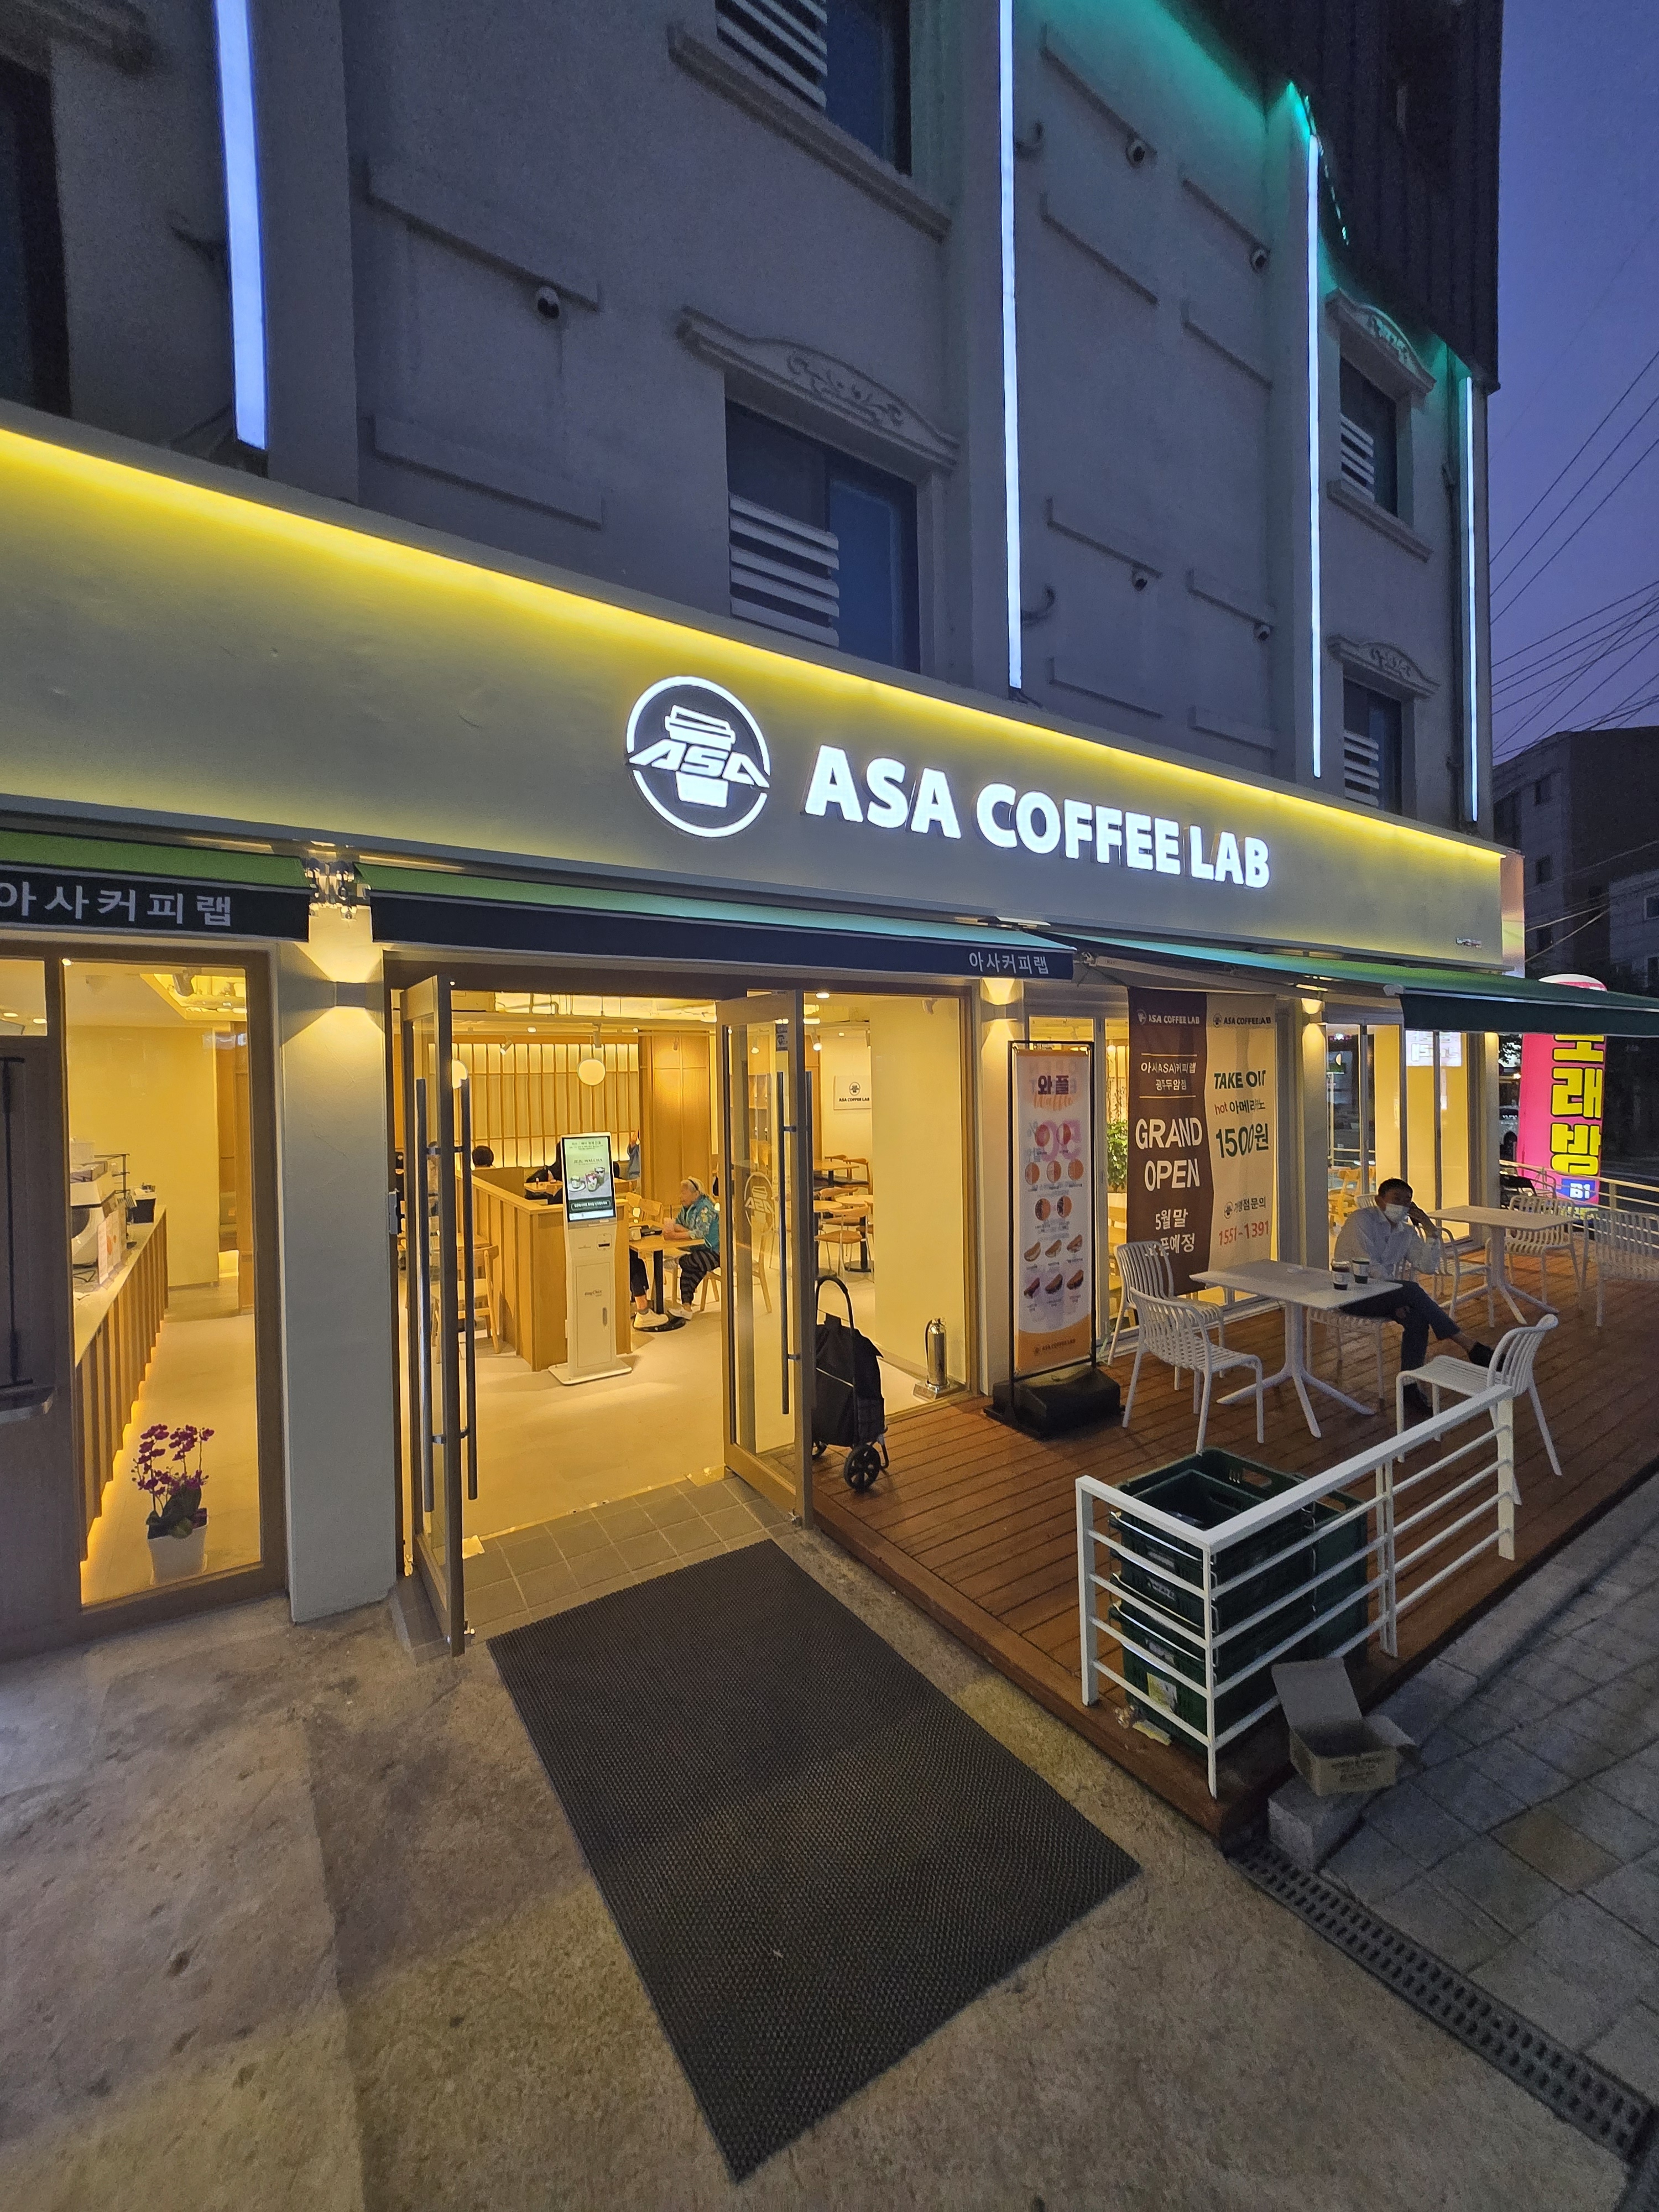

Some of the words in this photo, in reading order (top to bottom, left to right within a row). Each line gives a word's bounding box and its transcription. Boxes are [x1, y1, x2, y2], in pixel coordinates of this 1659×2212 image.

[628, 738, 770, 789] ASA
[804, 744, 962, 839] ASA
[976, 782, 1181, 875] COFFEE
[1190, 825, 1270, 889] LAB
[0, 881, 231, 927] 아사커피랩
[969, 951, 1049, 975] 아사커피랩
[1164, 1015, 1187, 1024] COFFEE
[1187, 1016, 1200, 1024] LAB
[1037, 1074, 1070, 1095] 와플
[1214, 1072, 1244, 1089] TAKE
[1214, 1101, 1228, 1115] hot
[1229, 1098, 1266, 1114] 아메리노
[1135, 1117, 1203, 1150] GRAND
[1215, 1123, 1269, 1159] 1500원
[1144, 1159, 1201, 1192] OPEN
[1144, 1233, 1196, 1256] 픈예정
[1218, 1220, 1269, 1246] 1551-1391
